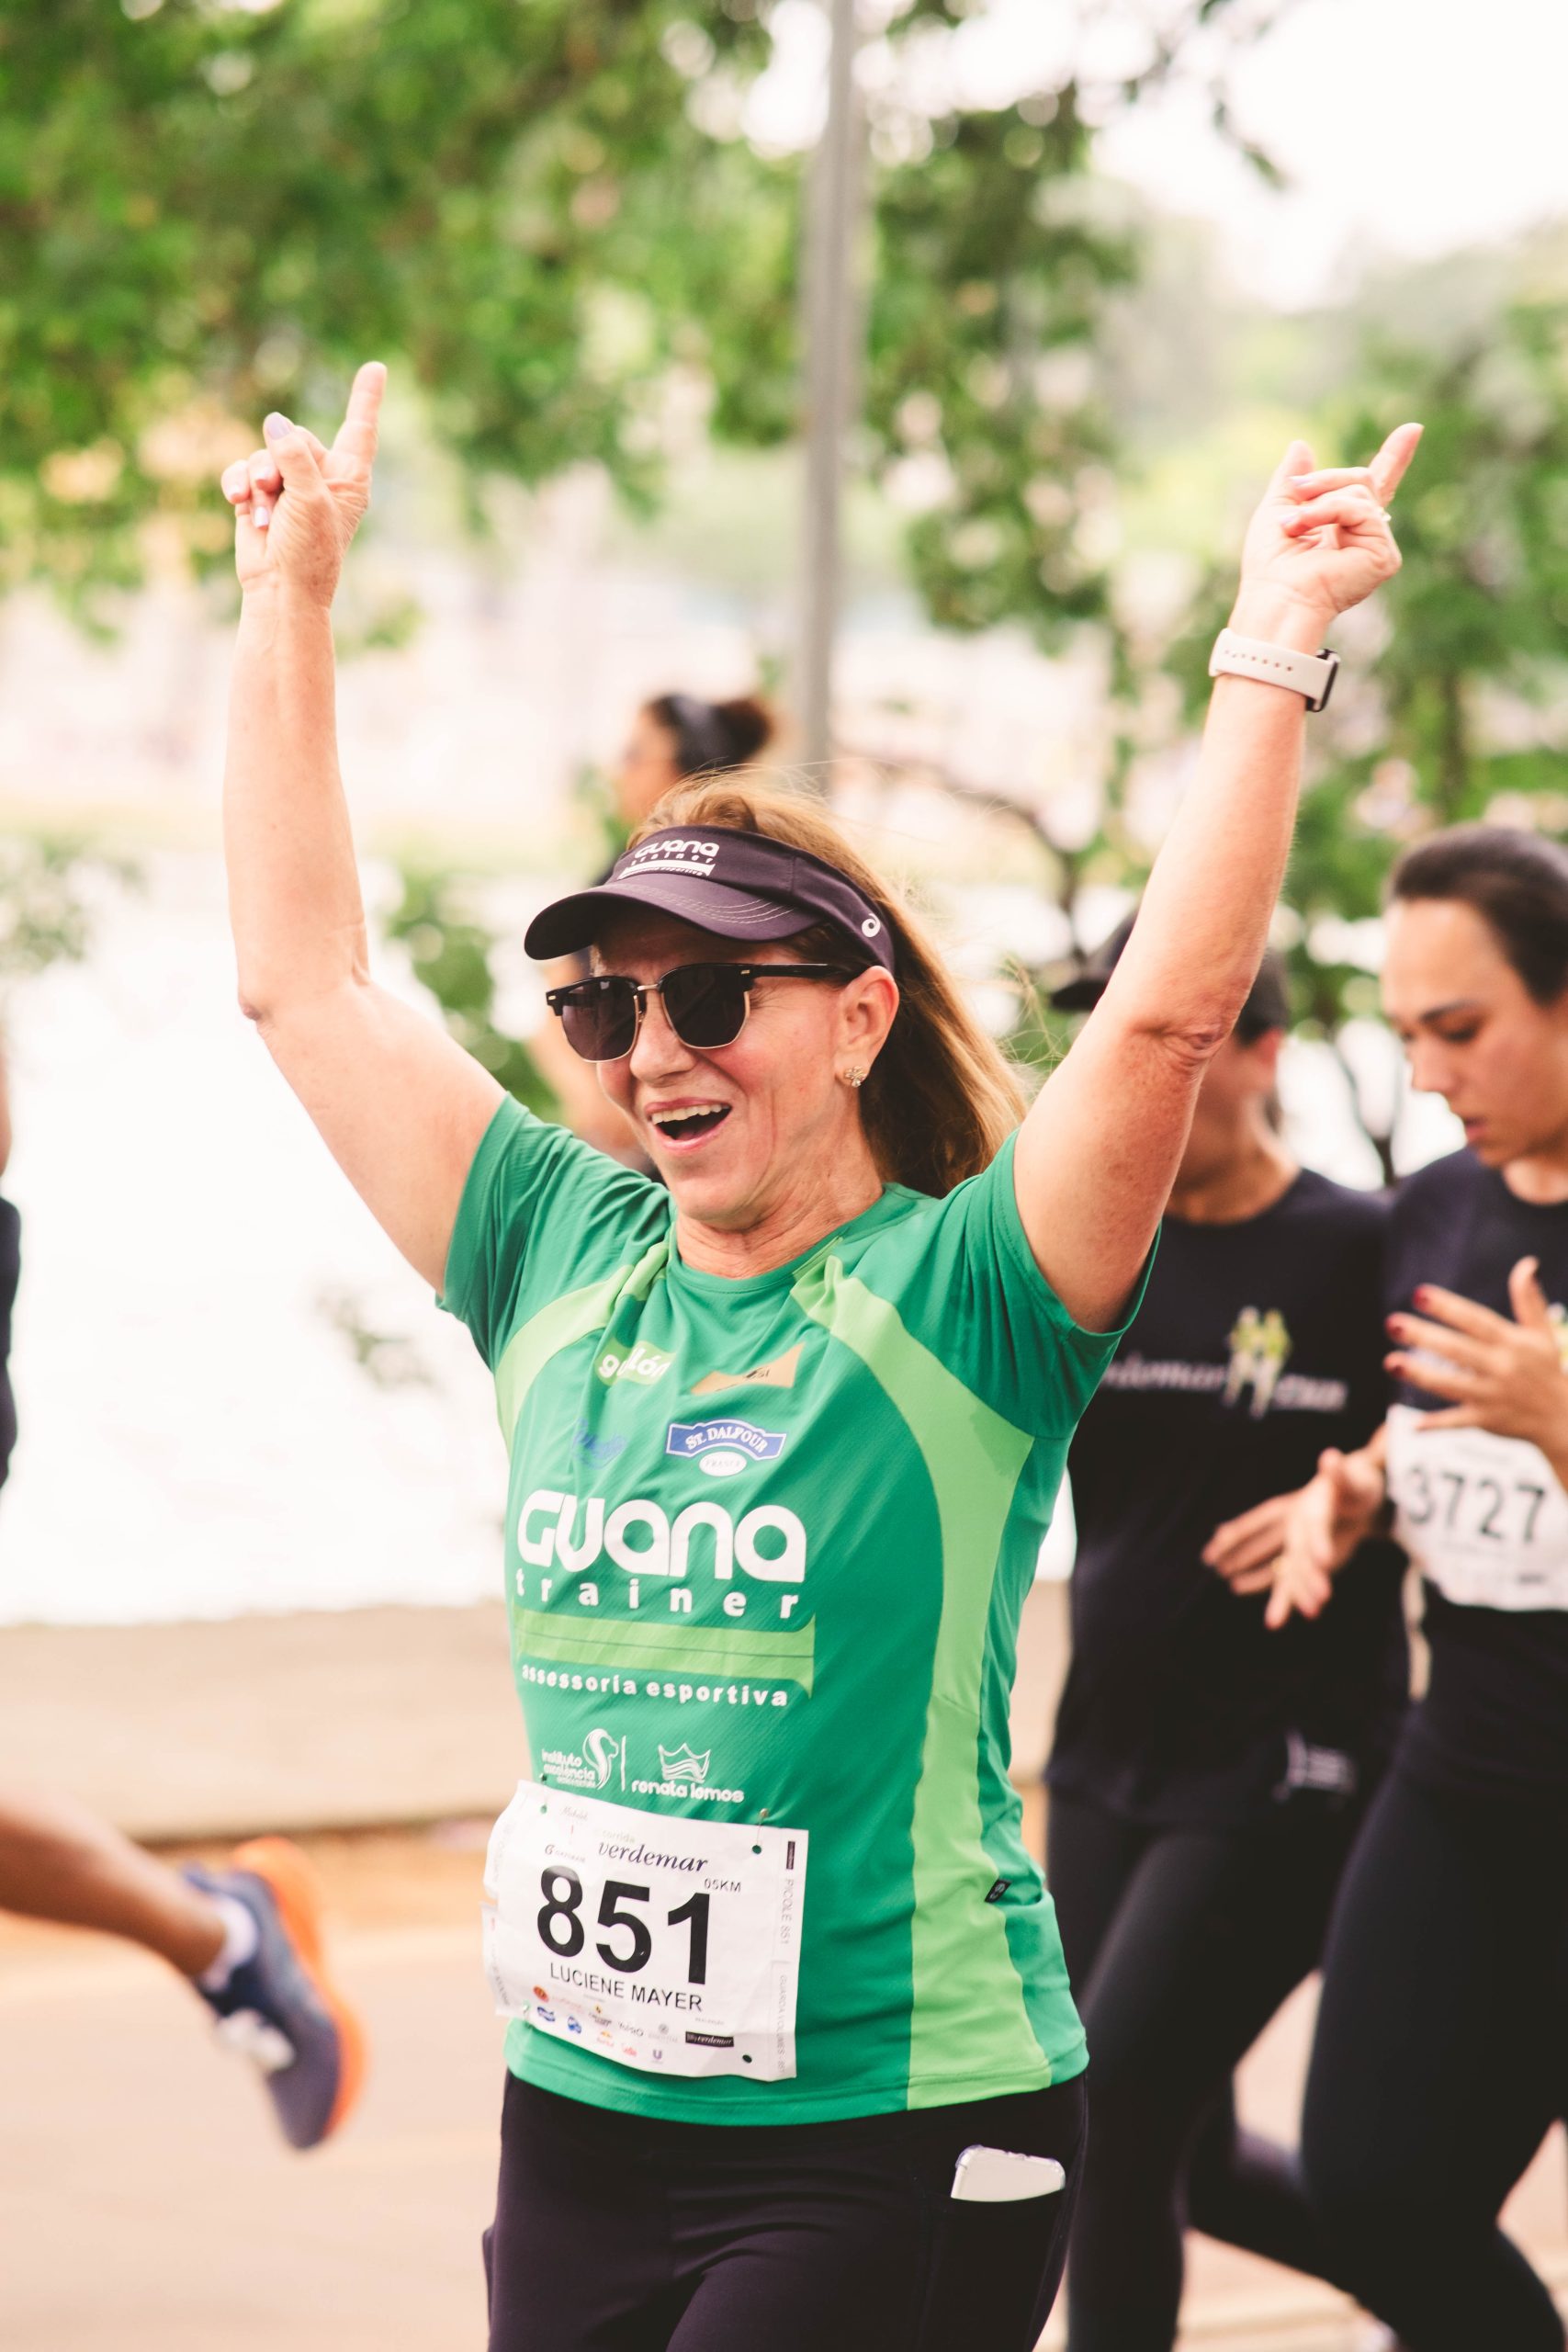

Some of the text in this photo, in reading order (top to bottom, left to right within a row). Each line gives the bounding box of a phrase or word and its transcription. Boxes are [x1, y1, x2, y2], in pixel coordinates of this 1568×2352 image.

[706, 1426, 768, 1453] DALFOUR
[1404, 1467, 1547, 1544] 3727
[516, 1567, 799, 1619] trainer
[522, 1664, 788, 1706] assessoria esportiva
[598, 1841, 708, 1872] verdemar
[704, 1877, 742, 1893] 05KM
[537, 1865, 711, 1985] 851
[550, 1962, 626, 1999] LUCIENE
[631, 1984, 704, 2013] MAYER
